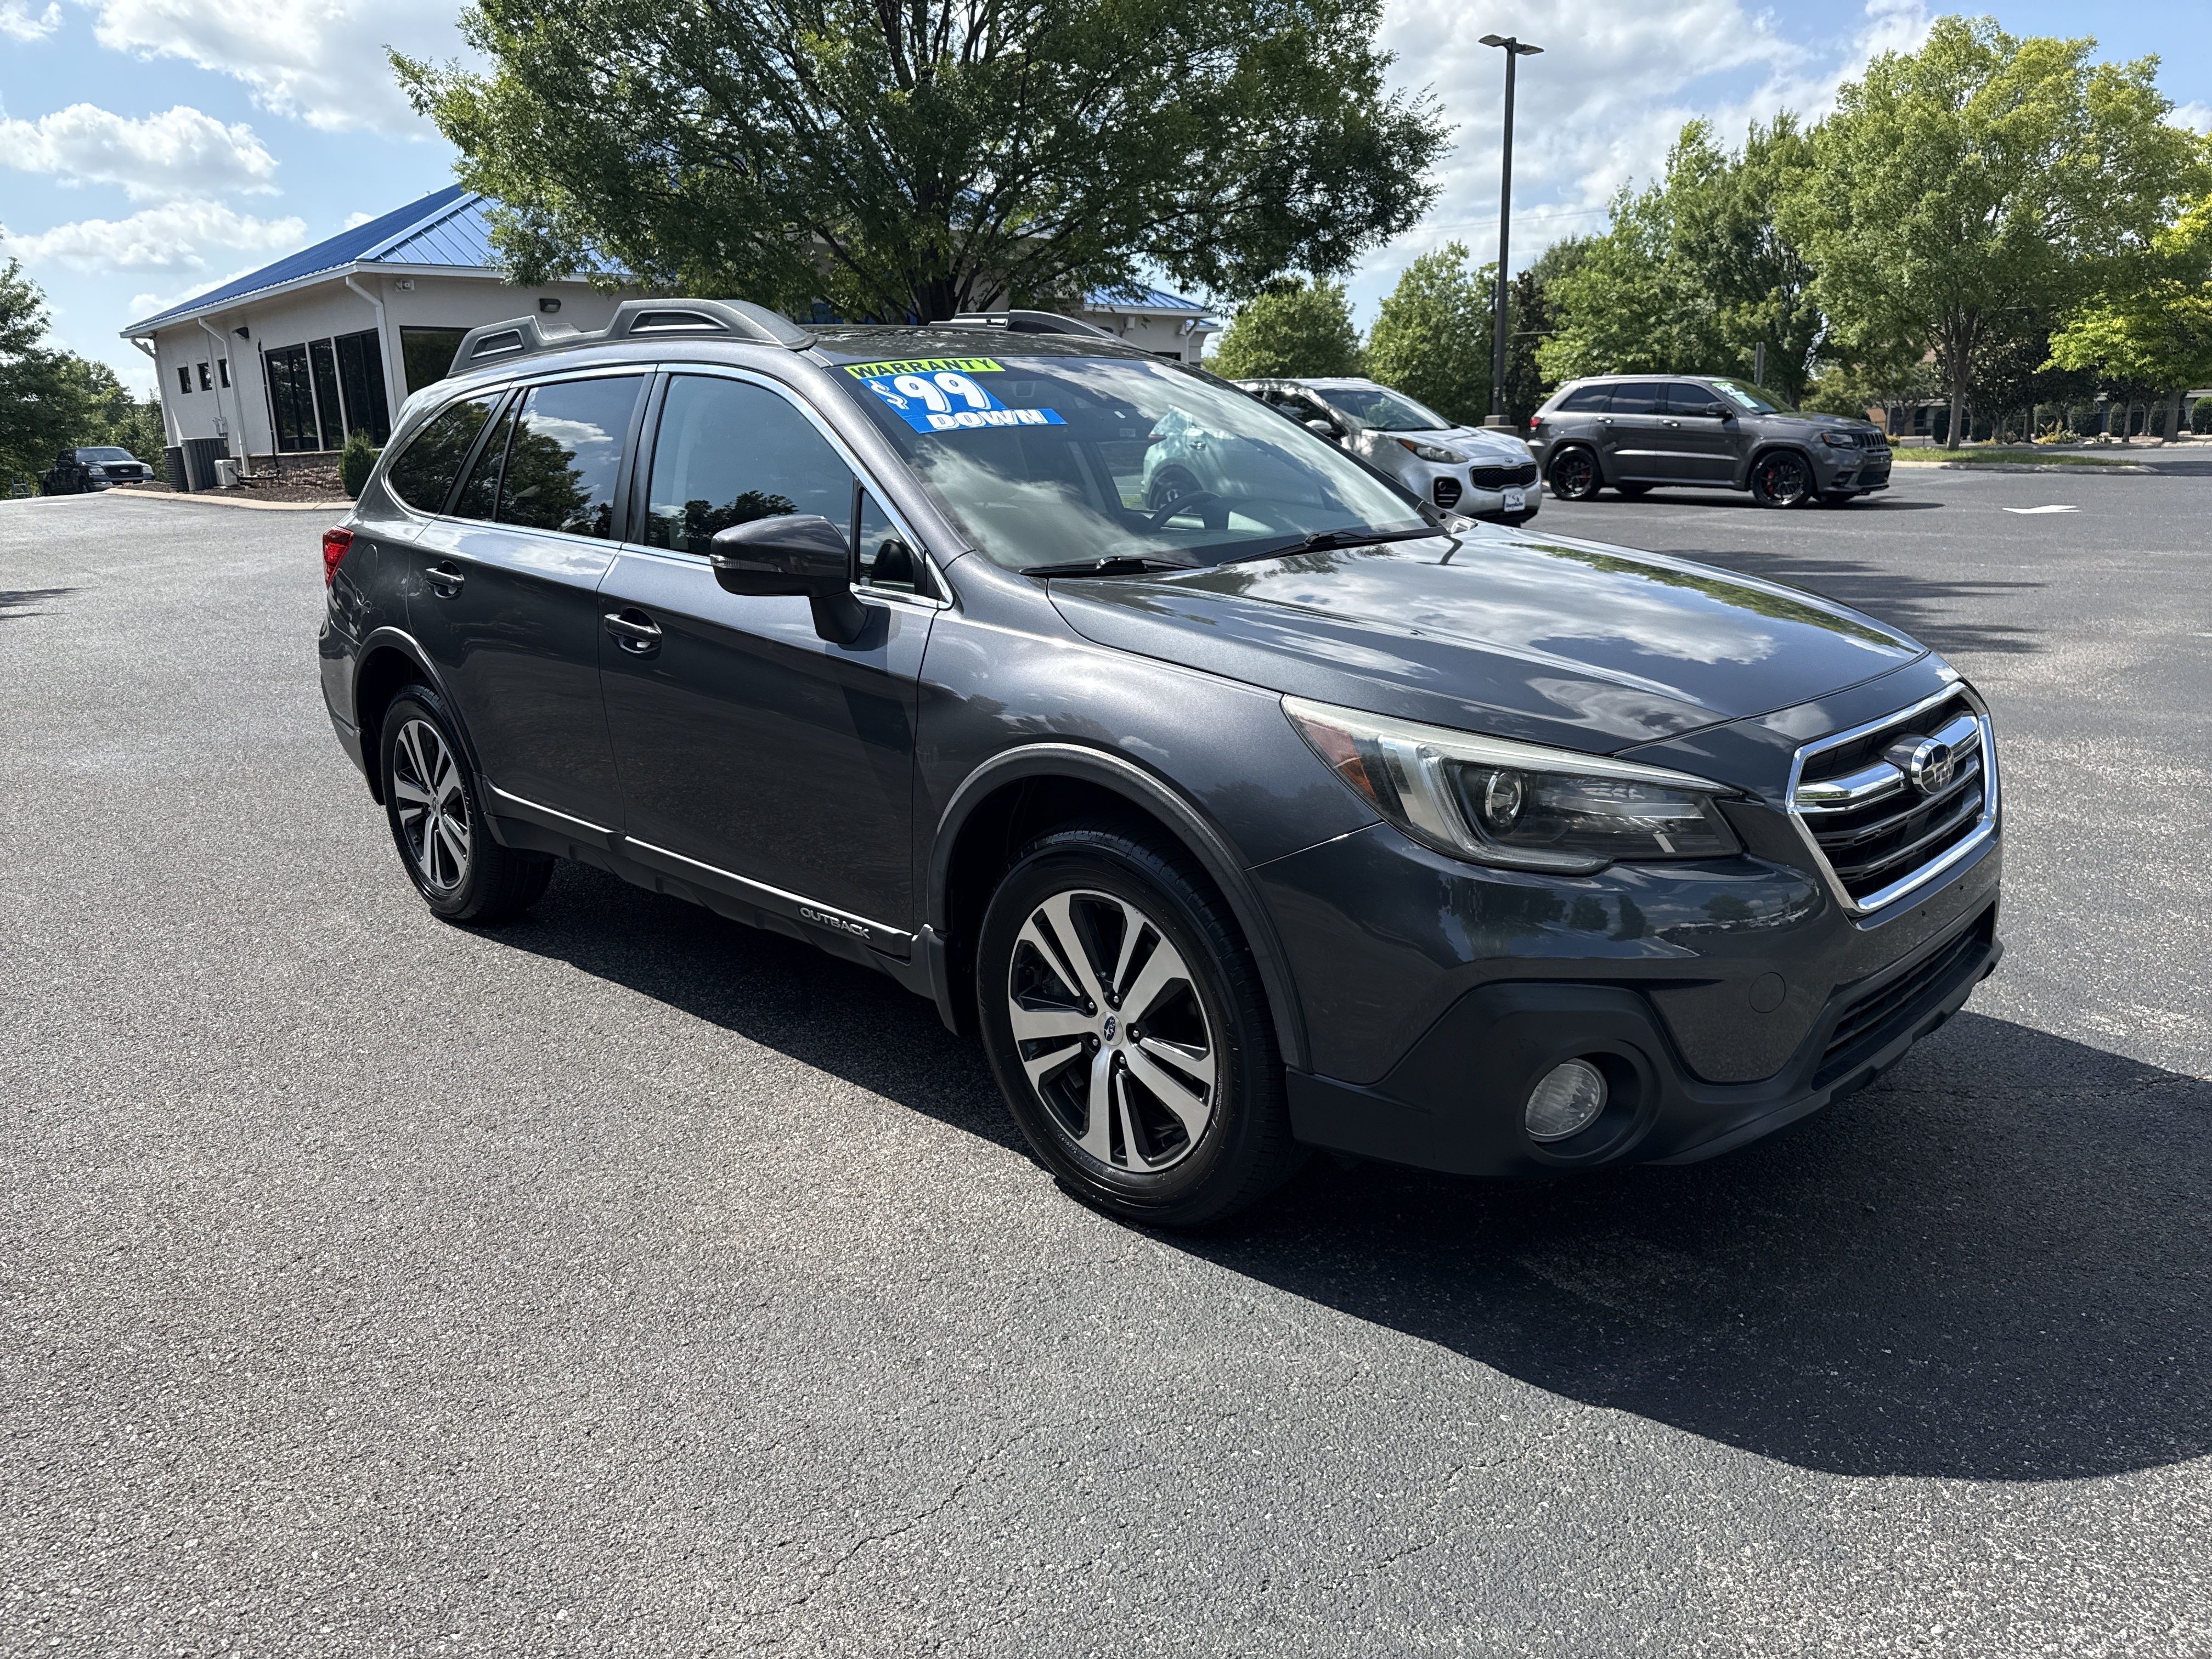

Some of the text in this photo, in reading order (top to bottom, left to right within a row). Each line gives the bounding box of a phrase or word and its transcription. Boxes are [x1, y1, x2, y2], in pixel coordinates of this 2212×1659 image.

[849, 359, 993, 378] WARRANTY
[868, 372, 991, 413] $99
[926, 409, 1048, 430] DOWN
[800, 907, 871, 939] OUTBACK
